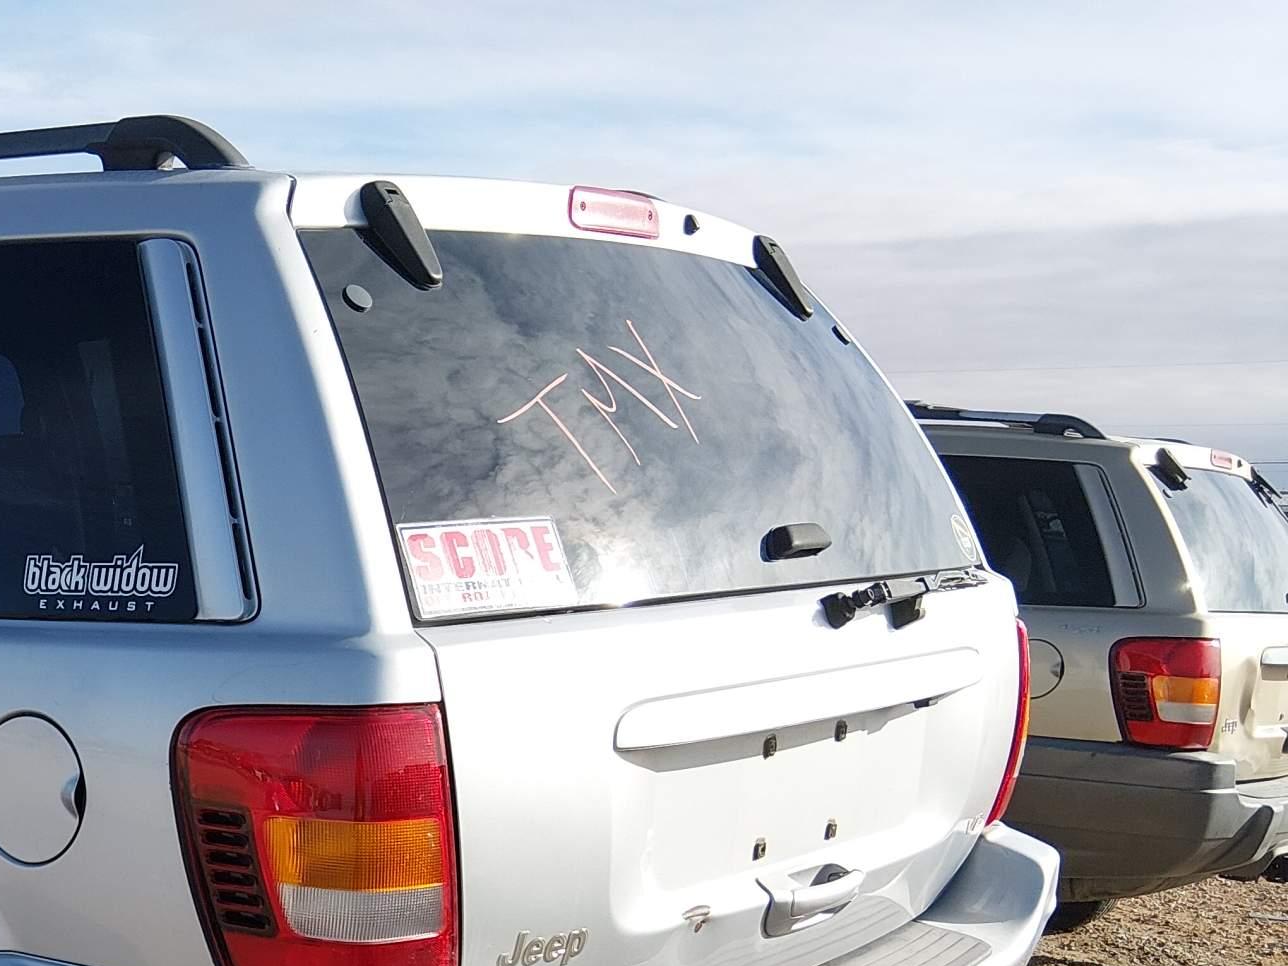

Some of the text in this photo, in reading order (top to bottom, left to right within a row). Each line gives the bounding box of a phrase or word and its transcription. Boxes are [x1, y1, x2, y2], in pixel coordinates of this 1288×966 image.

[497, 319, 702, 494] TMX
[24, 544, 179, 597] black widow
[407, 526, 562, 582] SCOPE
[39, 599, 155, 612] EXHAUST
